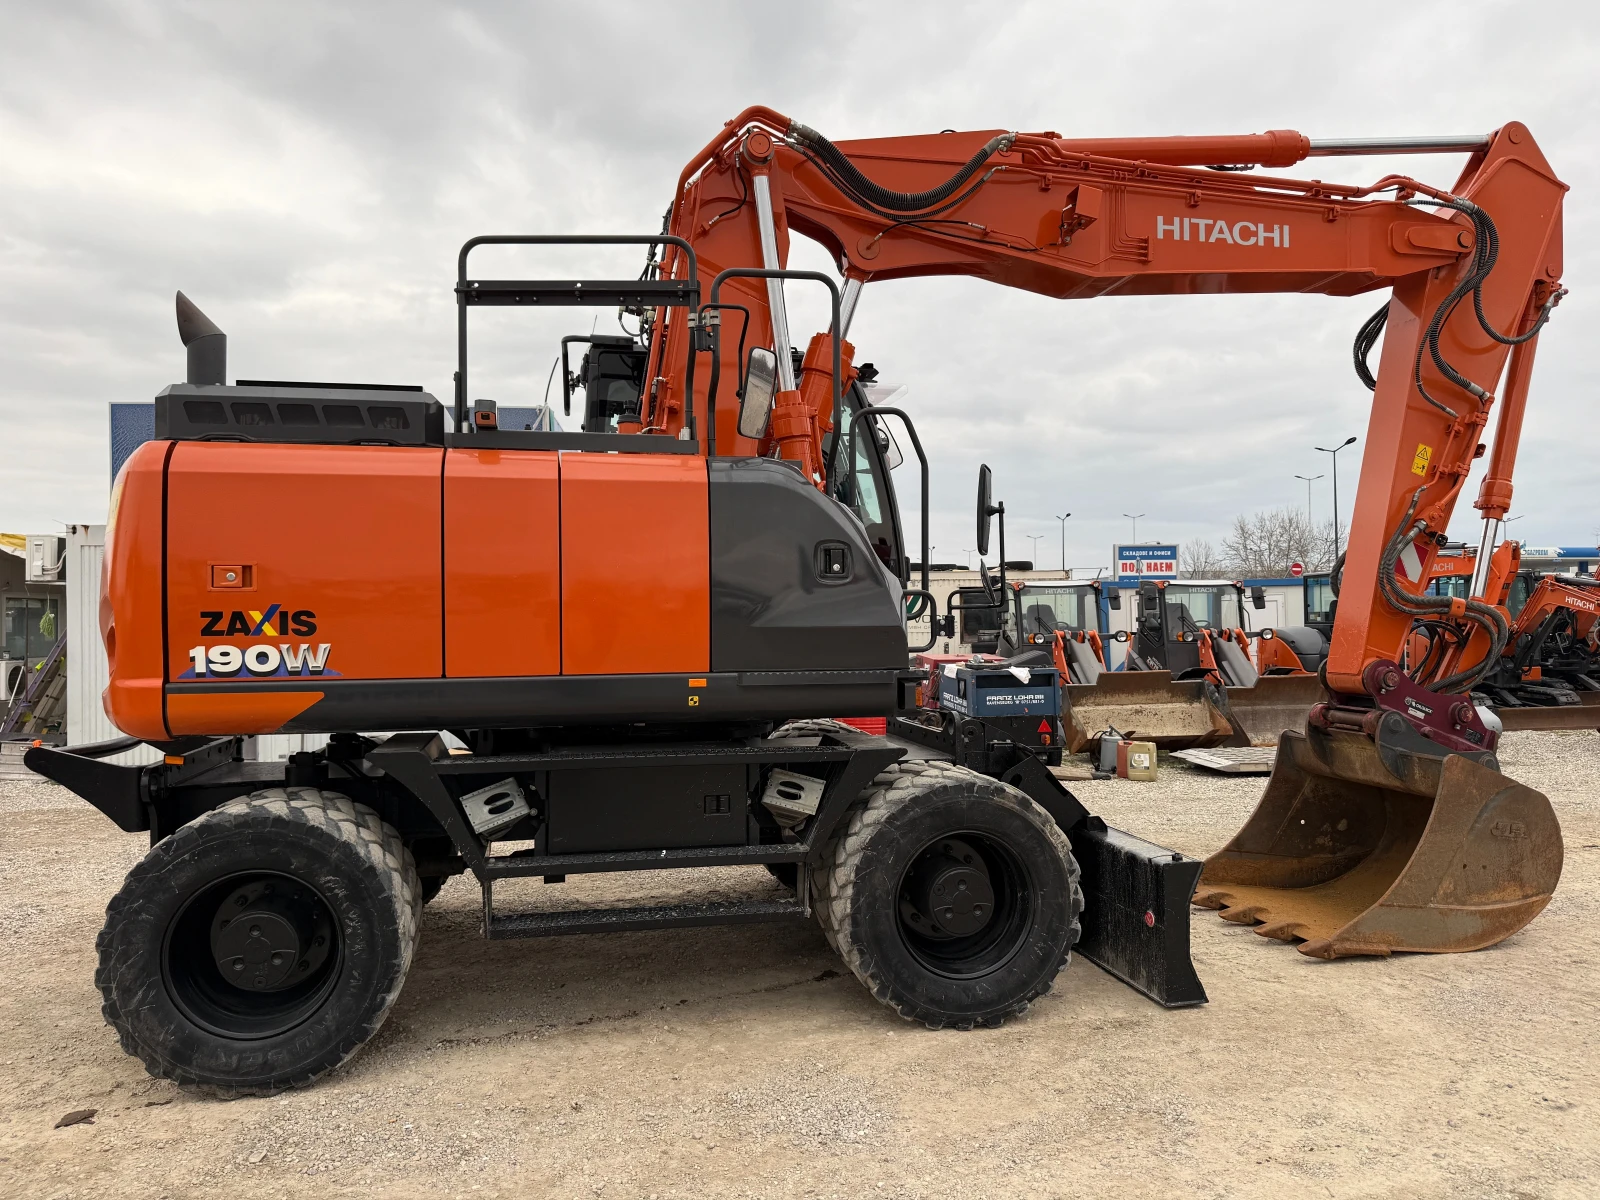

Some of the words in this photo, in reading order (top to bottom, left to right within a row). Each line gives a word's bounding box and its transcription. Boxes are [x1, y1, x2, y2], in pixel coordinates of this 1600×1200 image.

[1156, 215, 1290, 248] HITACHI
[1146, 562, 1173, 572] НАЕМ
[1432, 562, 1454, 572] ACHI
[1564, 595, 1595, 611] HITACHI
[200, 603, 318, 637] ZAXIS
[188, 643, 332, 678] 190W
